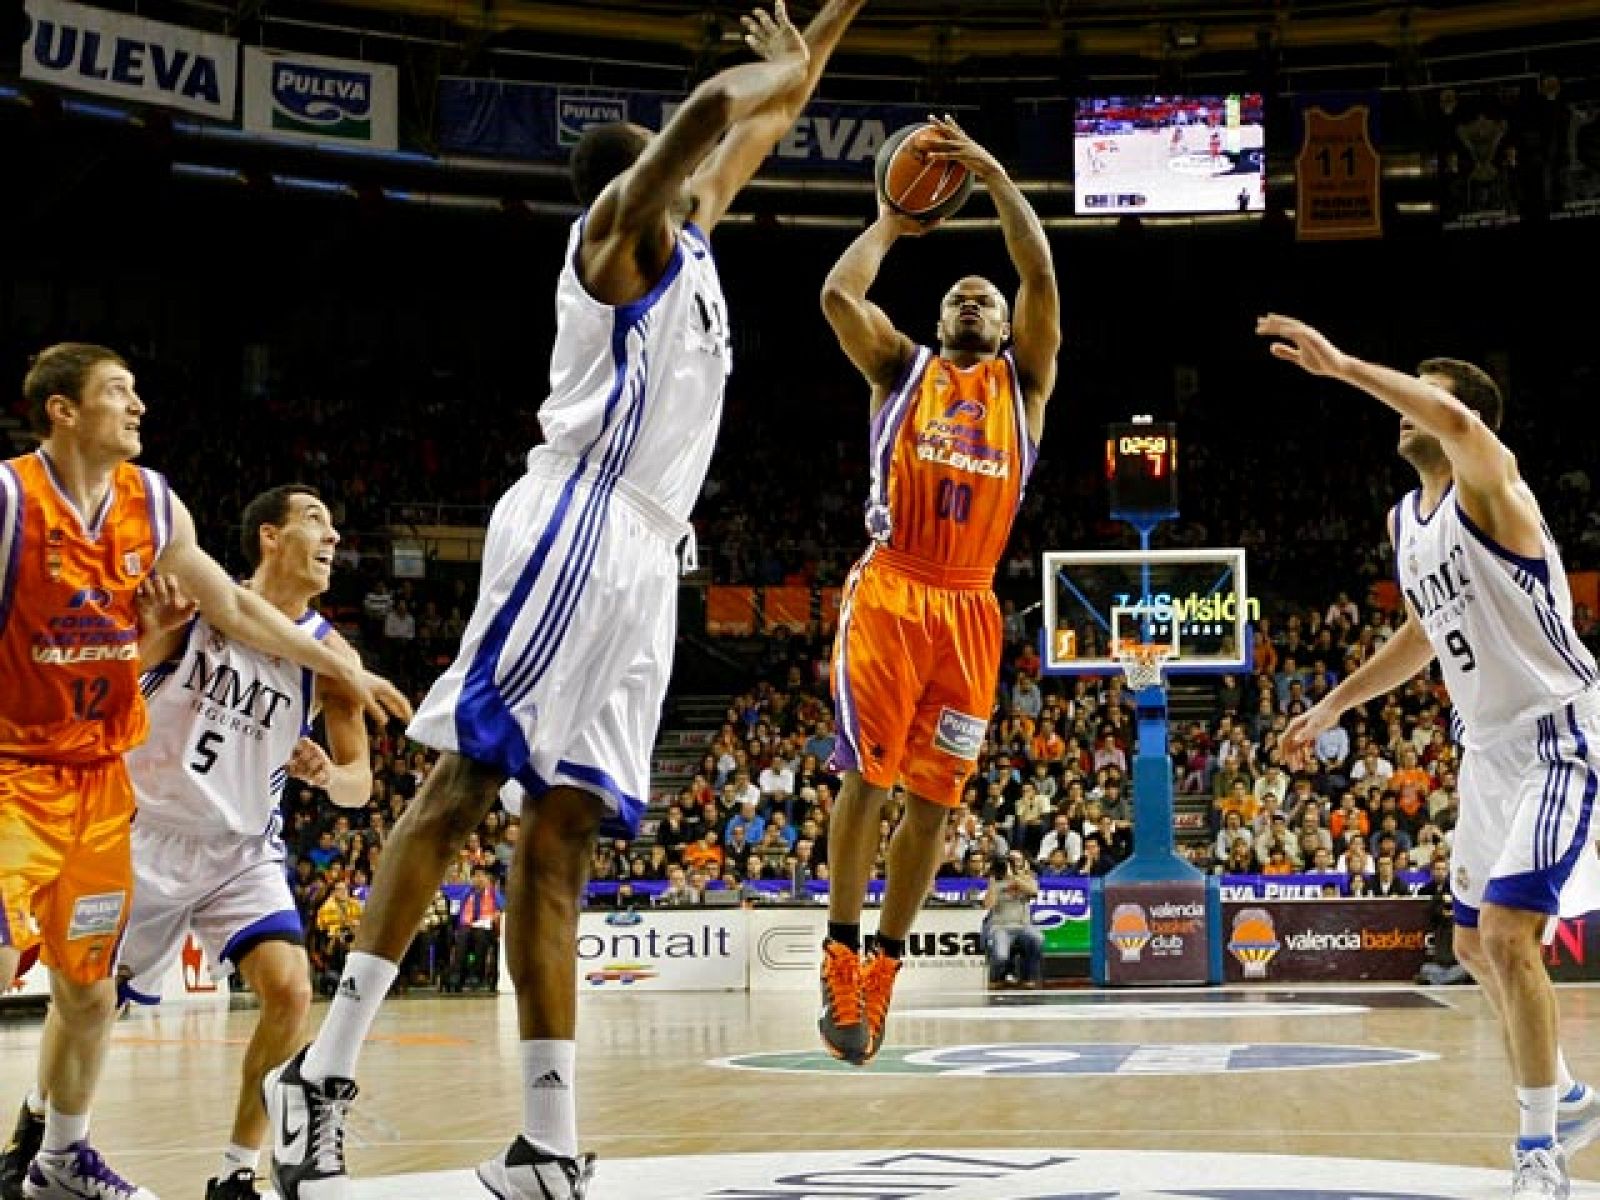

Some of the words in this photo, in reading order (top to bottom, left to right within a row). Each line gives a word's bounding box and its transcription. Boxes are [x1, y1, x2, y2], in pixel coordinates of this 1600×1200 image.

[277, 69, 365, 100] PULEVA
[937, 478, 972, 522] 00
[1445, 628, 1476, 672] 9
[73, 677, 110, 721] 12
[182, 650, 291, 730] MMT
[190, 729, 225, 775] 5
[1150, 901, 1206, 919] valencia
[576, 924, 731, 959] ontalt
